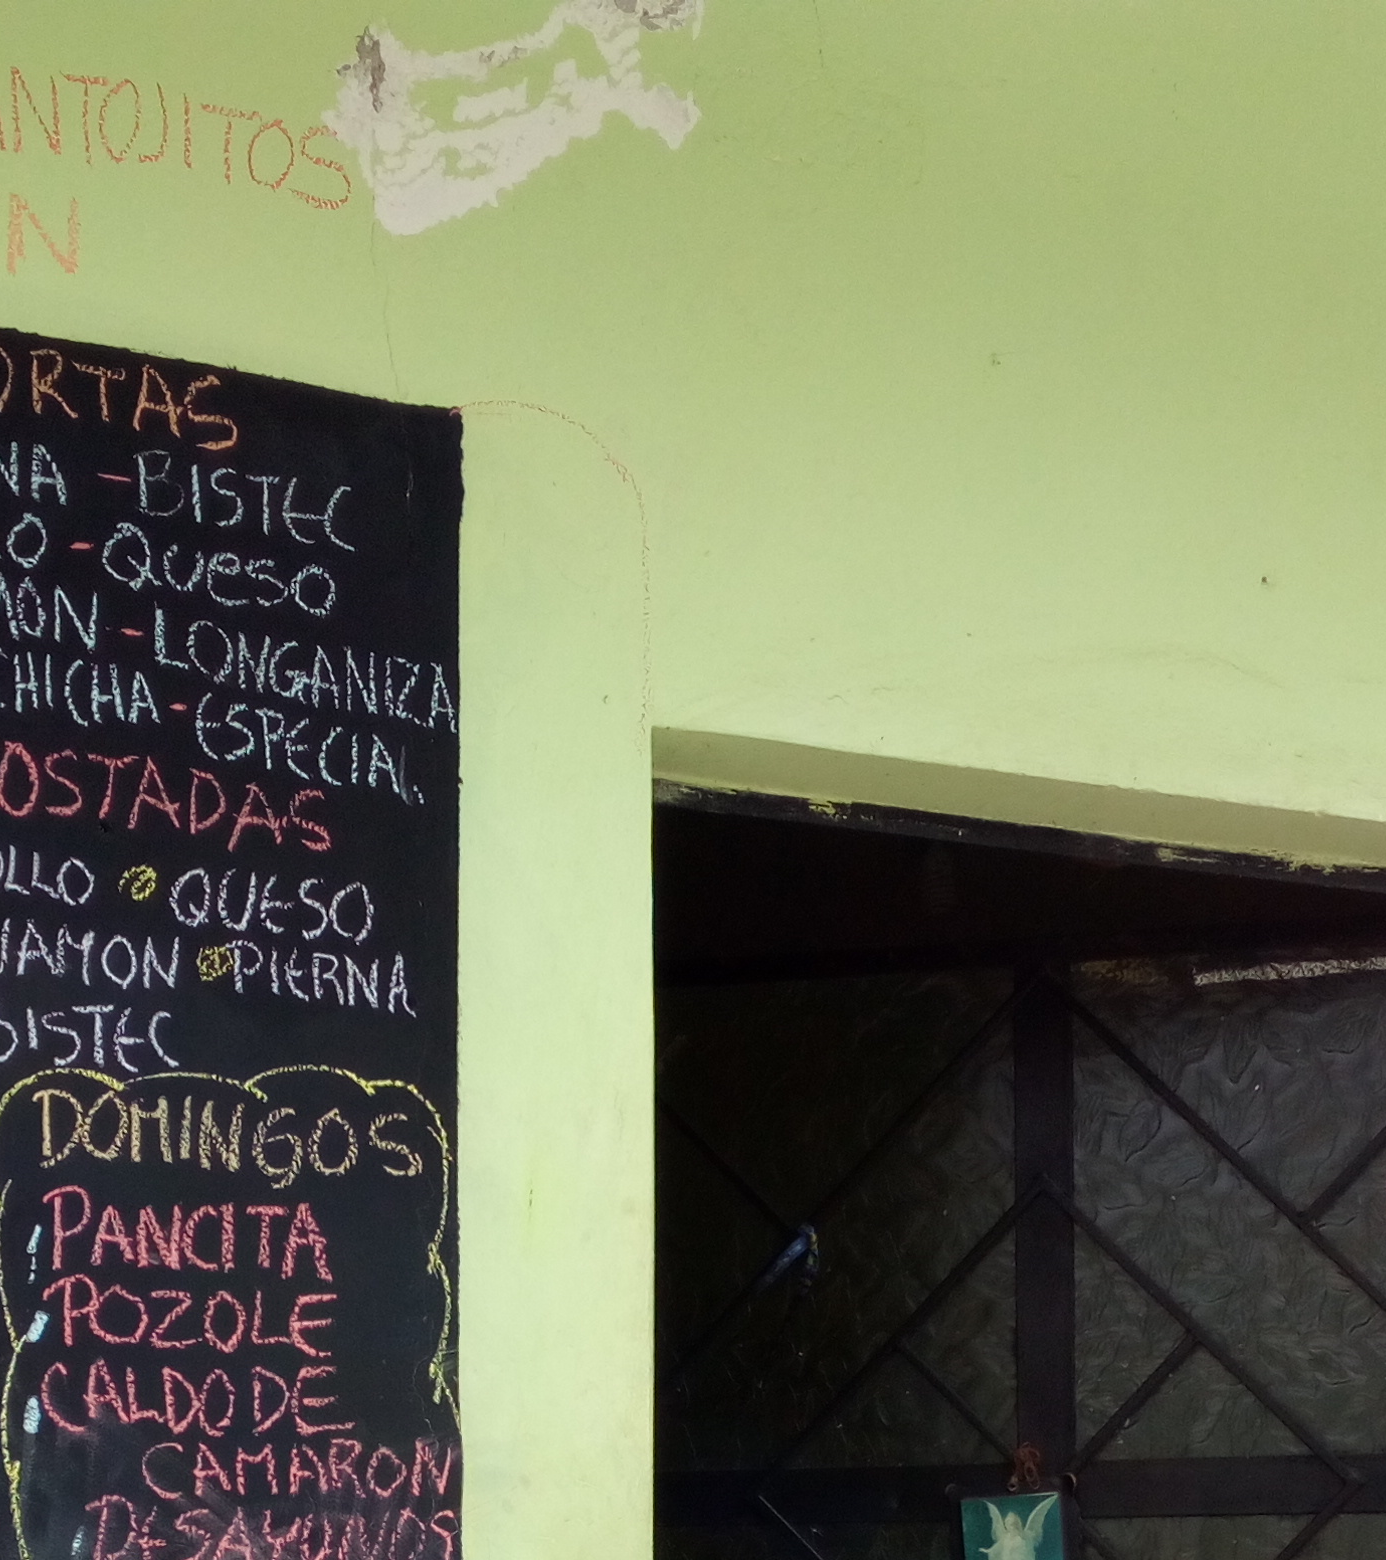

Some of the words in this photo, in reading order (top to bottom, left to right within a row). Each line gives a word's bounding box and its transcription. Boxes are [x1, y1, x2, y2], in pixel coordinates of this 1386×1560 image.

[168, 866, 376, 944] QUESO
[228, 939, 417, 1018] PIERNA
[32, 1088, 424, 1190] DOMINGOS
[42, 1184, 334, 1284] PANCITA
[42, 1273, 339, 1358] POZOLE
[40, 1359, 236, 1437] CALDO
[251, 1365, 357, 1437] DE
[141, 1438, 451, 1500] CAMARON
